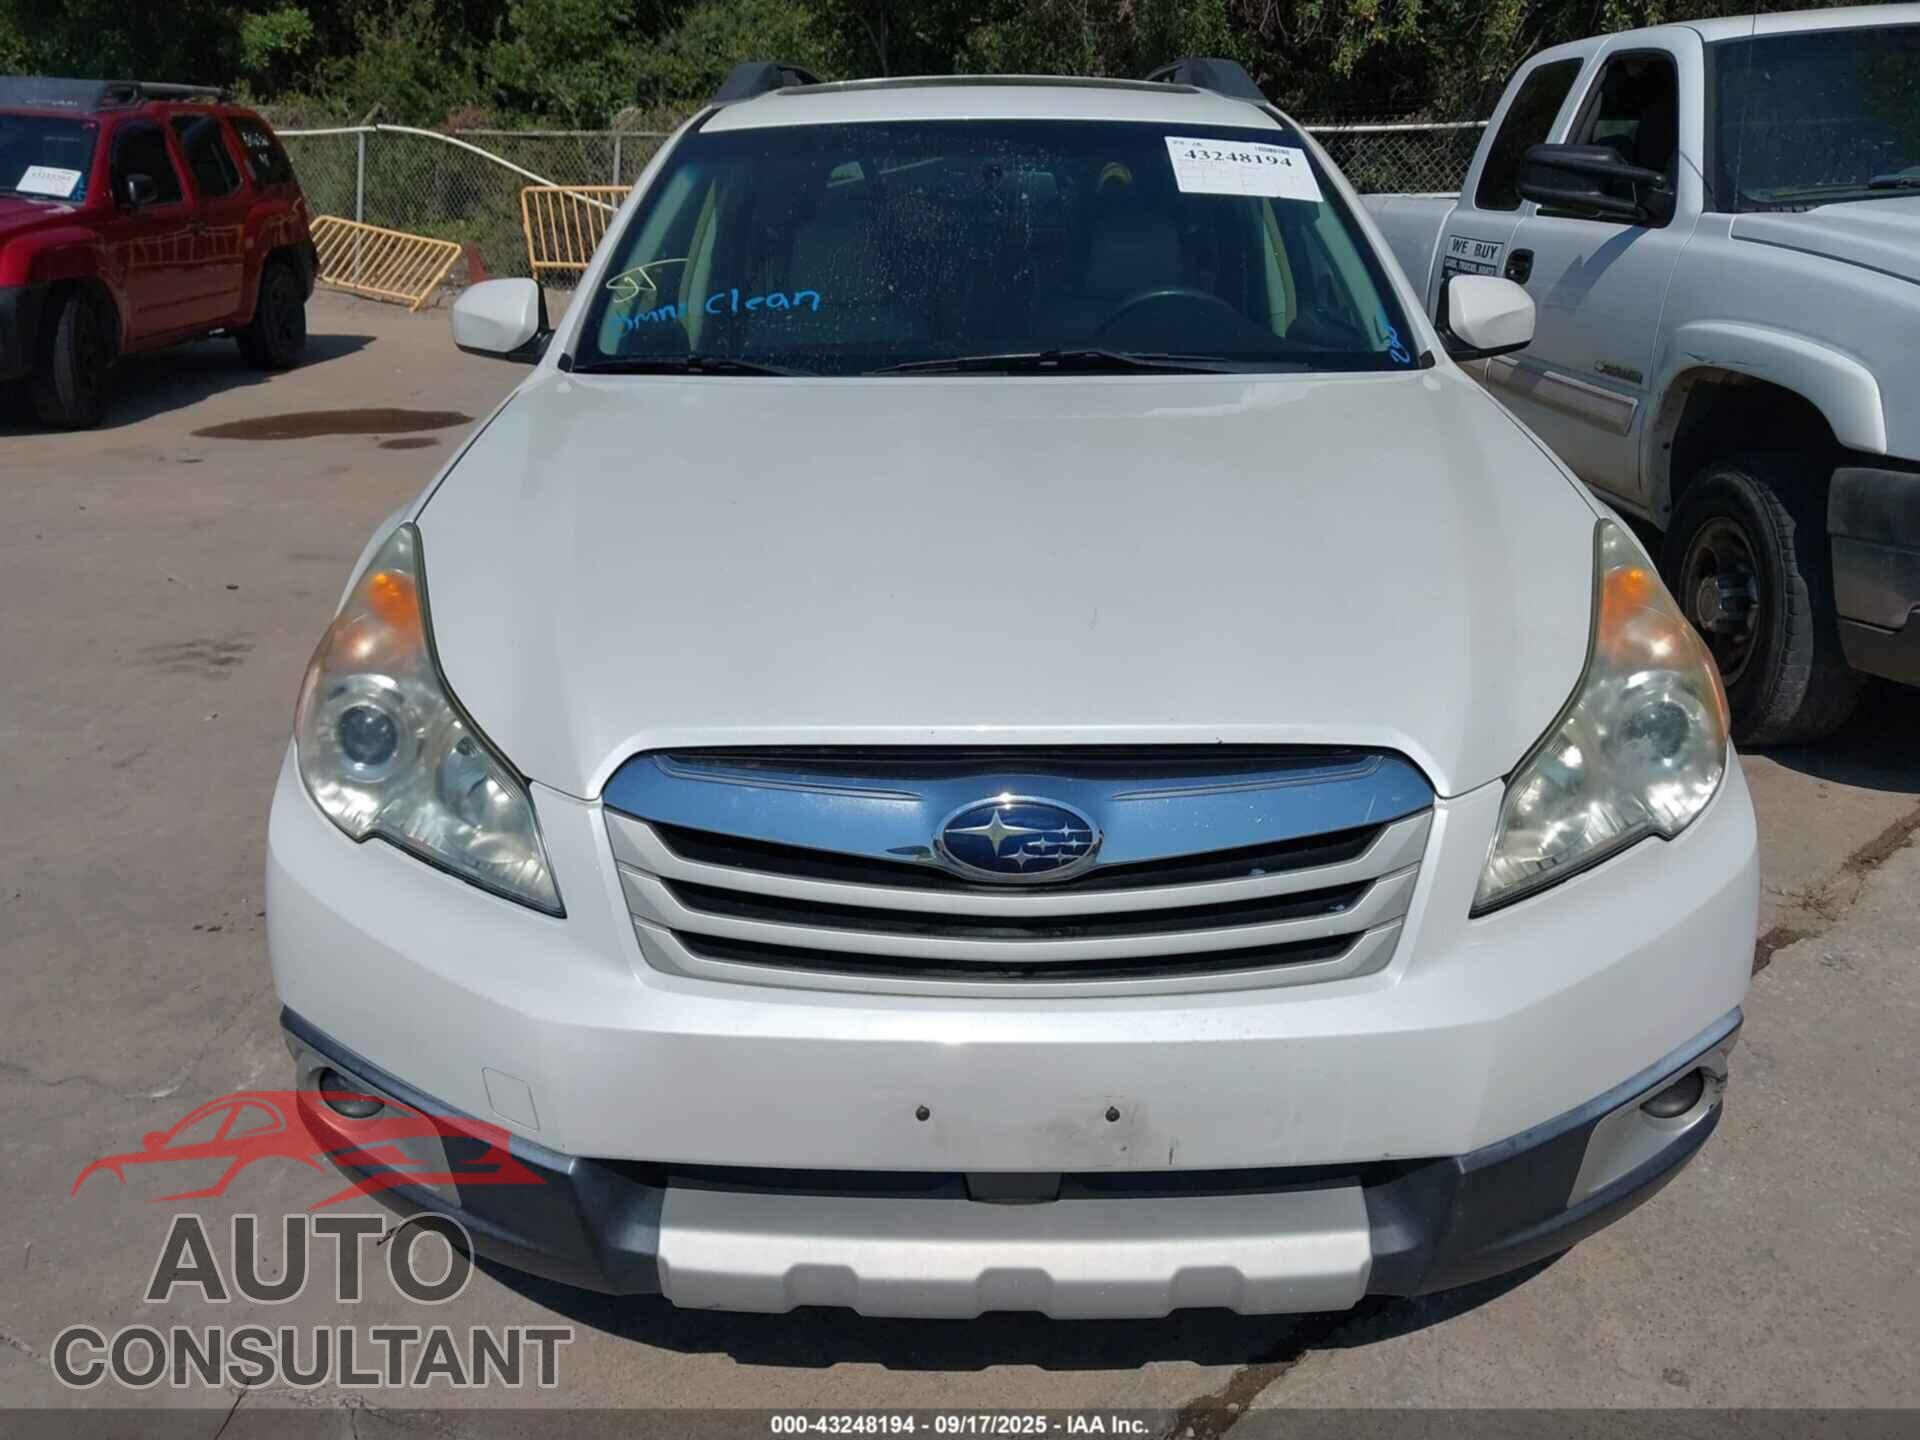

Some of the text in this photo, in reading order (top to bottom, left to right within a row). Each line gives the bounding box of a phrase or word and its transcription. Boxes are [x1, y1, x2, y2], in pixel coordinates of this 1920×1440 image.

[1184, 149, 1293, 167] 43248194
[1452, 238, 1499, 259] WE BUY
